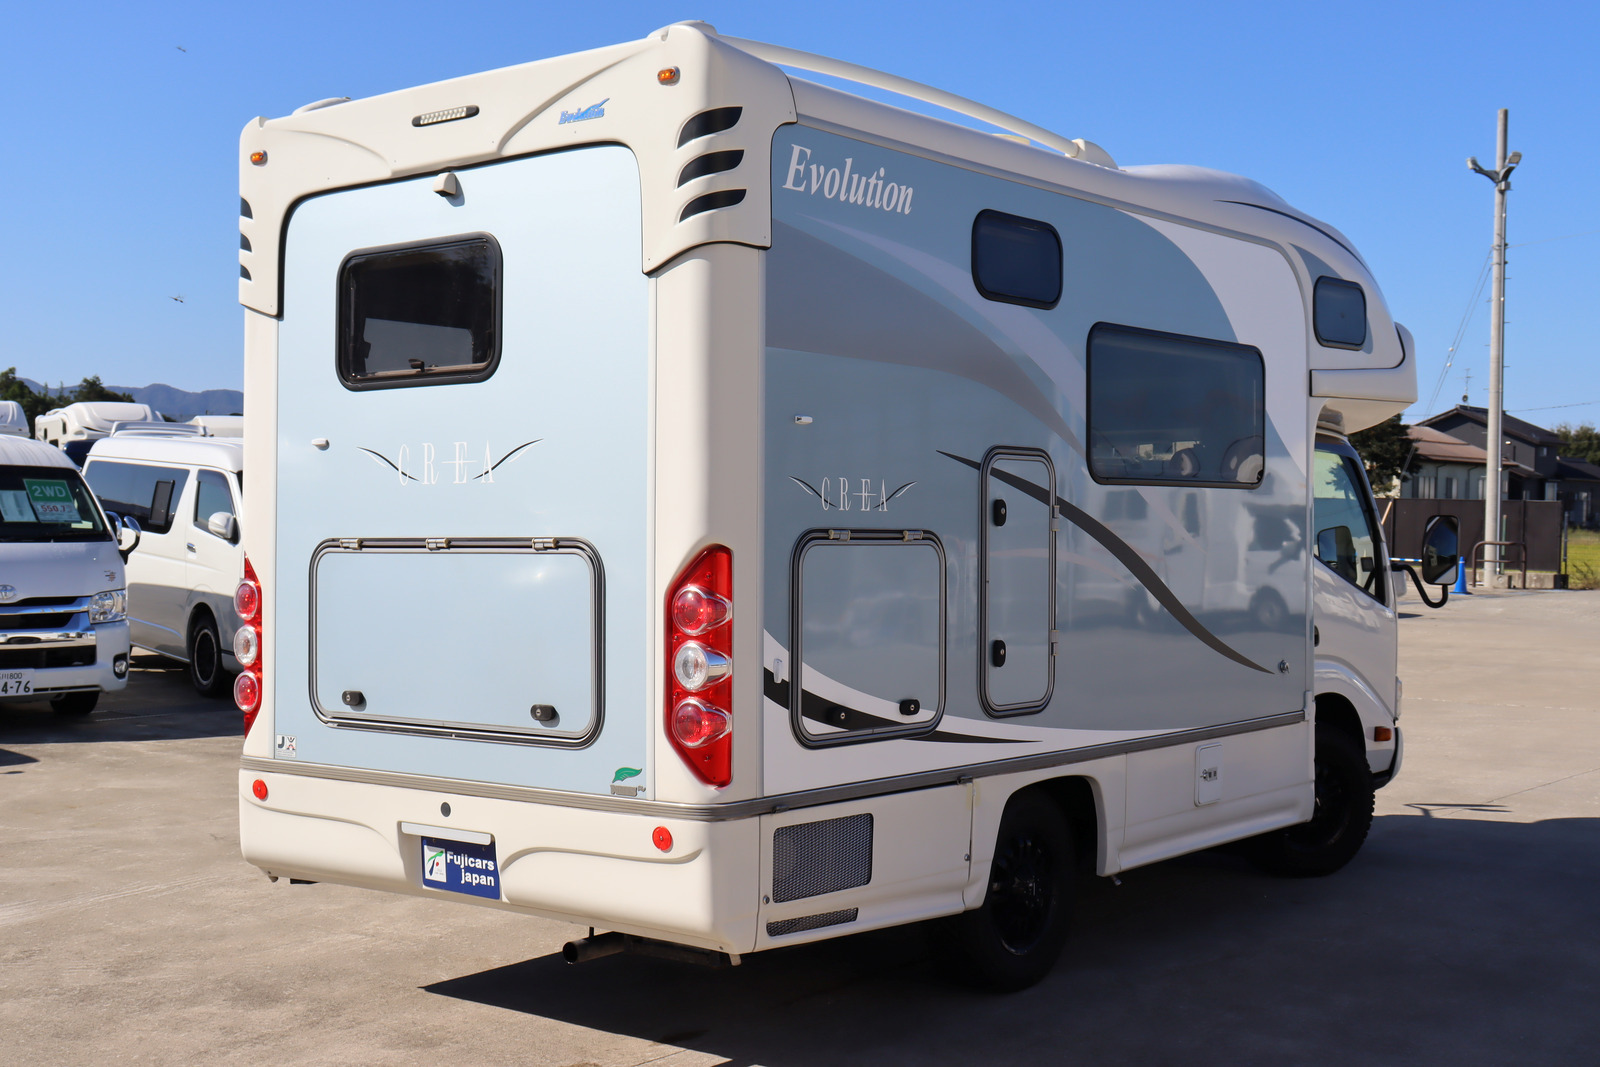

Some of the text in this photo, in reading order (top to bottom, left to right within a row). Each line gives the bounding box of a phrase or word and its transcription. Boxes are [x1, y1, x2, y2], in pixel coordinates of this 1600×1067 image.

[782, 143, 914, 215] Evolution
[398, 439, 495, 486] CREA
[31, 485, 66, 498] 2WD
[821, 476, 888, 512] CREA
[446, 851, 495, 871] Fujicars
